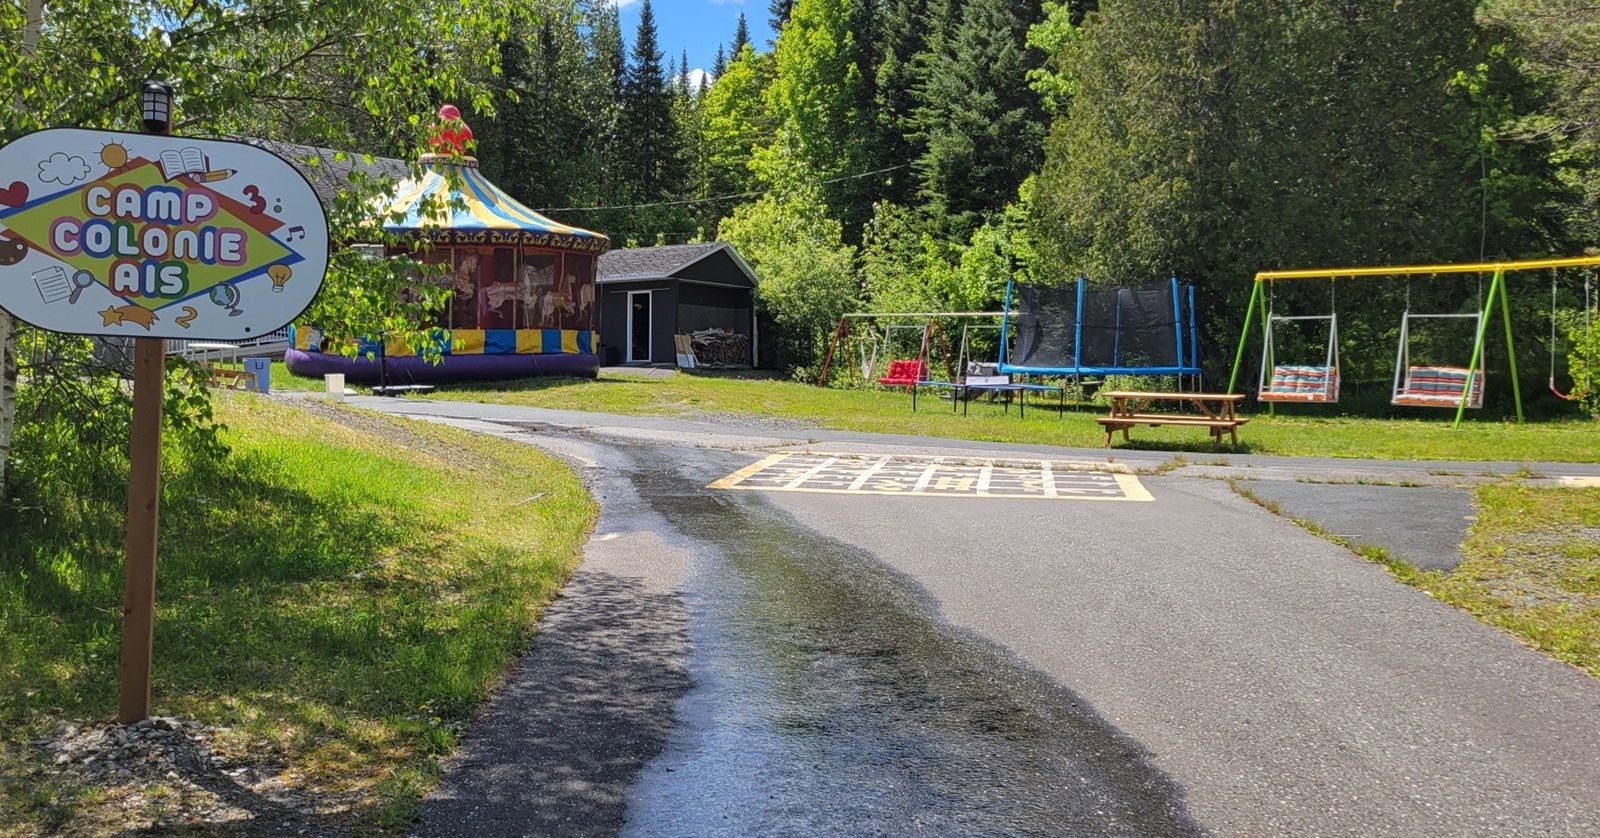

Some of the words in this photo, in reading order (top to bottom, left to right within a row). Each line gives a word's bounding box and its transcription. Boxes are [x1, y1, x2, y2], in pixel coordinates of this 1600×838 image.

[86, 185, 213, 223] CAMP
[242, 185, 267, 214] 3
[52, 220, 243, 262] COLONIE
[113, 261, 185, 295] AIS
[174, 306, 199, 329] 2
